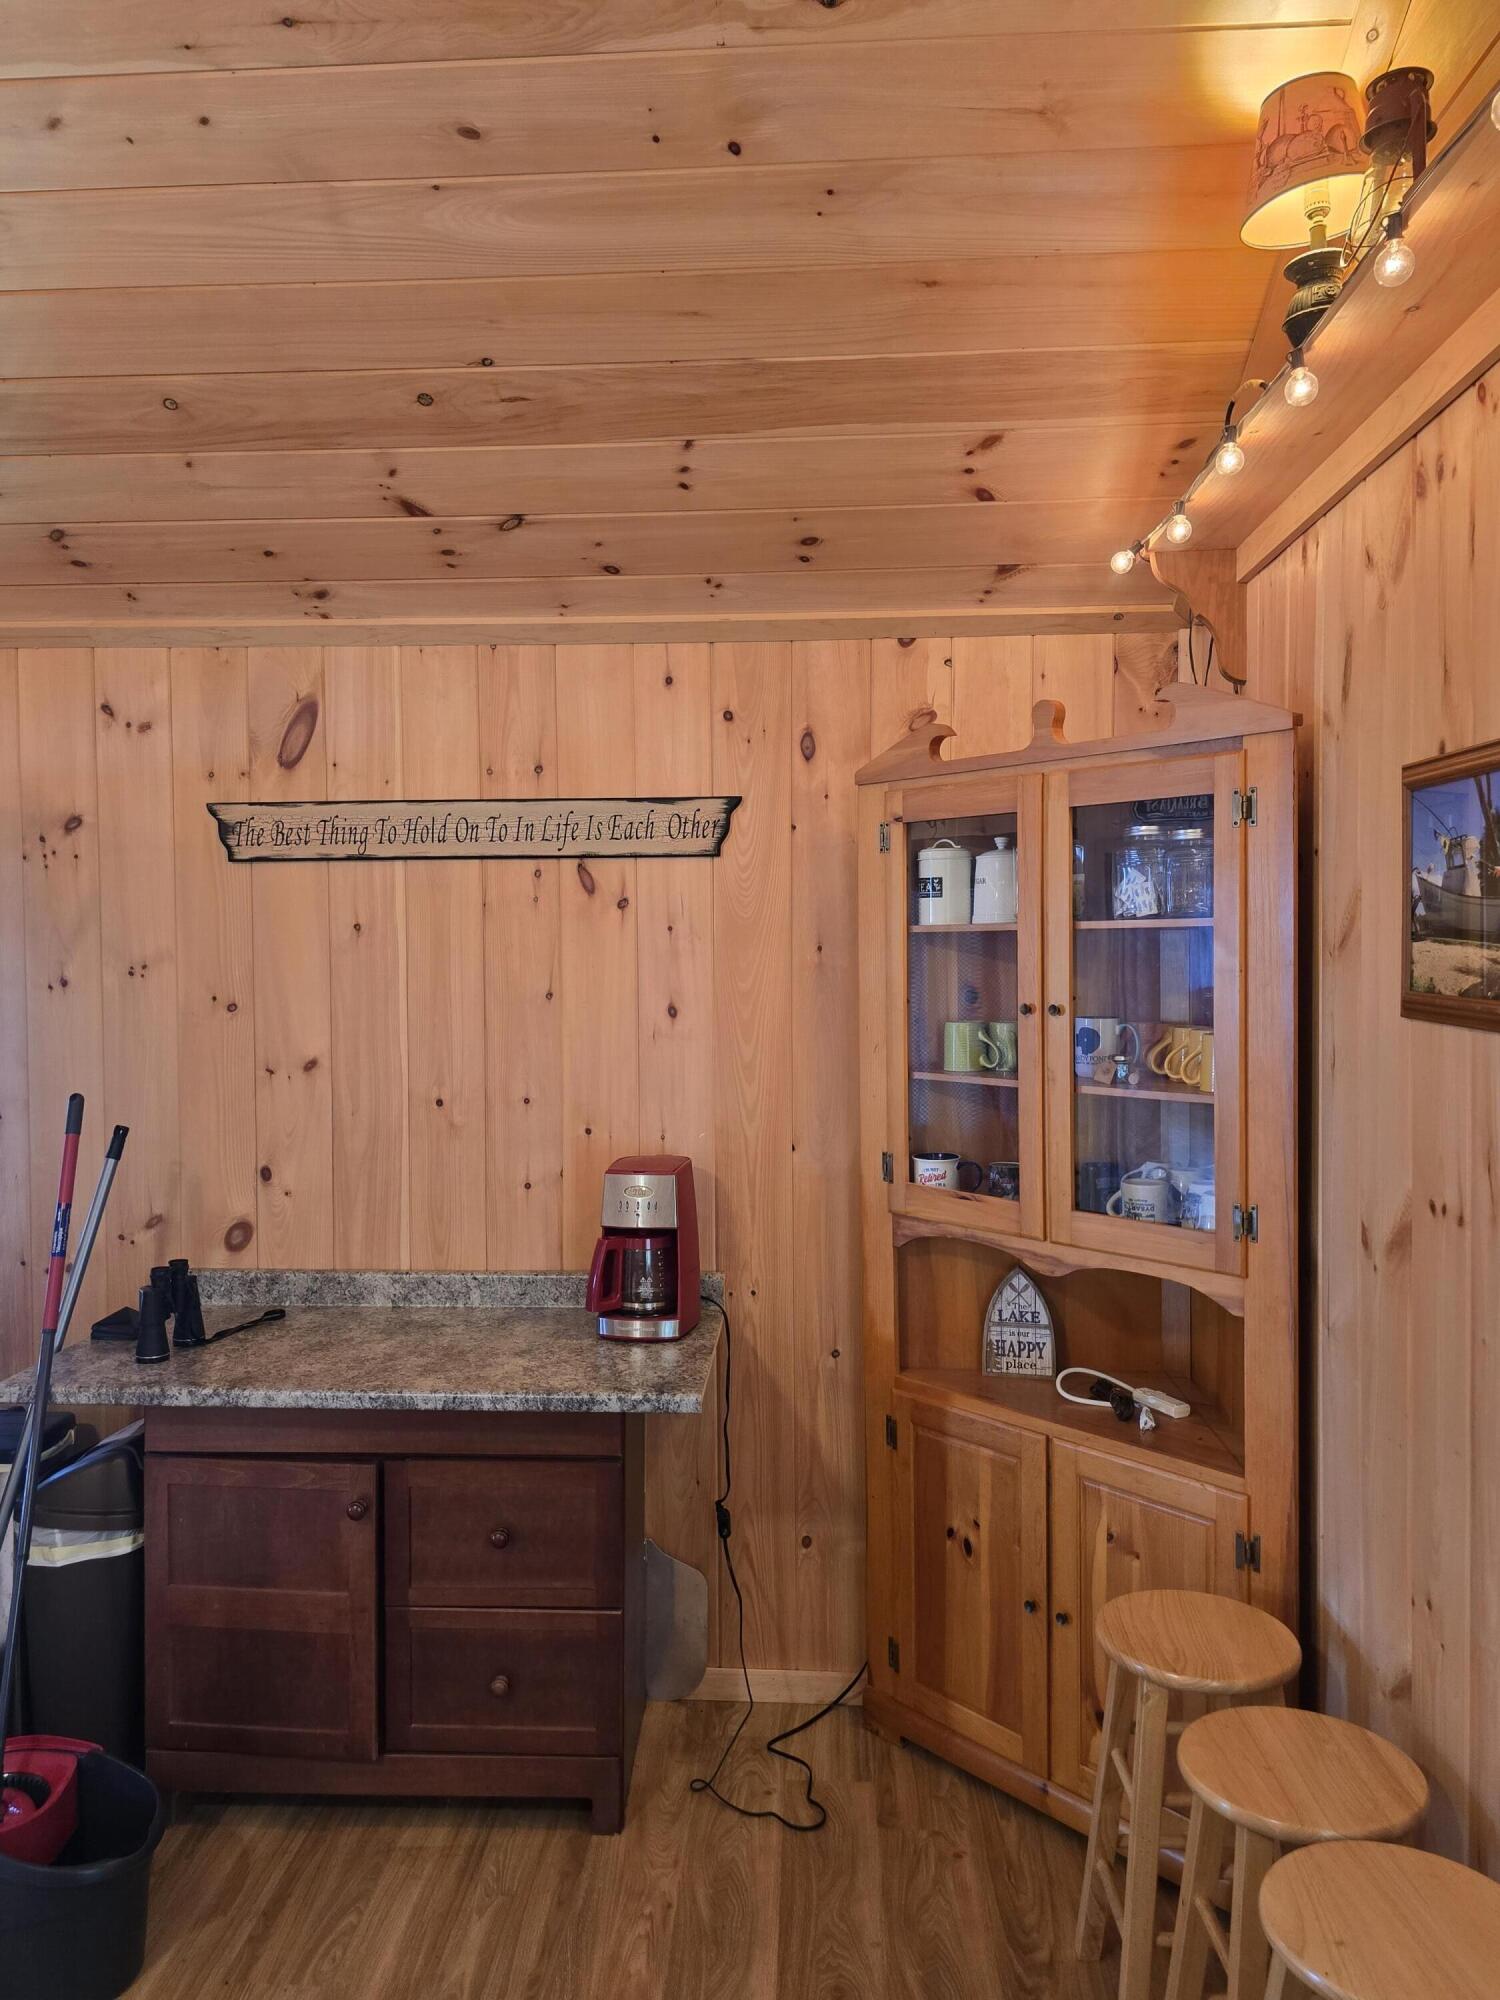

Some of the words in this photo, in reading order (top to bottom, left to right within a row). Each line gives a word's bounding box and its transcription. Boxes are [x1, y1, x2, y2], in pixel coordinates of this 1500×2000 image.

[232, 816, 264, 847] The
[271, 820, 311, 847] Best
[316, 815, 369, 855] Thing
[375, 815, 397, 845] To
[401, 813, 452, 845] Hold
[455, 816, 479, 843] On
[485, 814, 508, 843] To
[513, 815, 535, 843] In
[541, 810, 579, 852] Life
[585, 814, 603, 841] Is
[607, 809, 655, 841] Each
[668, 808, 721, 840] Other
[918, 1170, 947, 1185] Retired
[997, 1309, 1041, 1324] LAKE
[1009, 1329, 1017, 1337] is
[1017, 1330, 1030, 1338] our
[995, 1340, 1047, 1359] HAPPY
[1005, 1359, 1037, 1370] place
